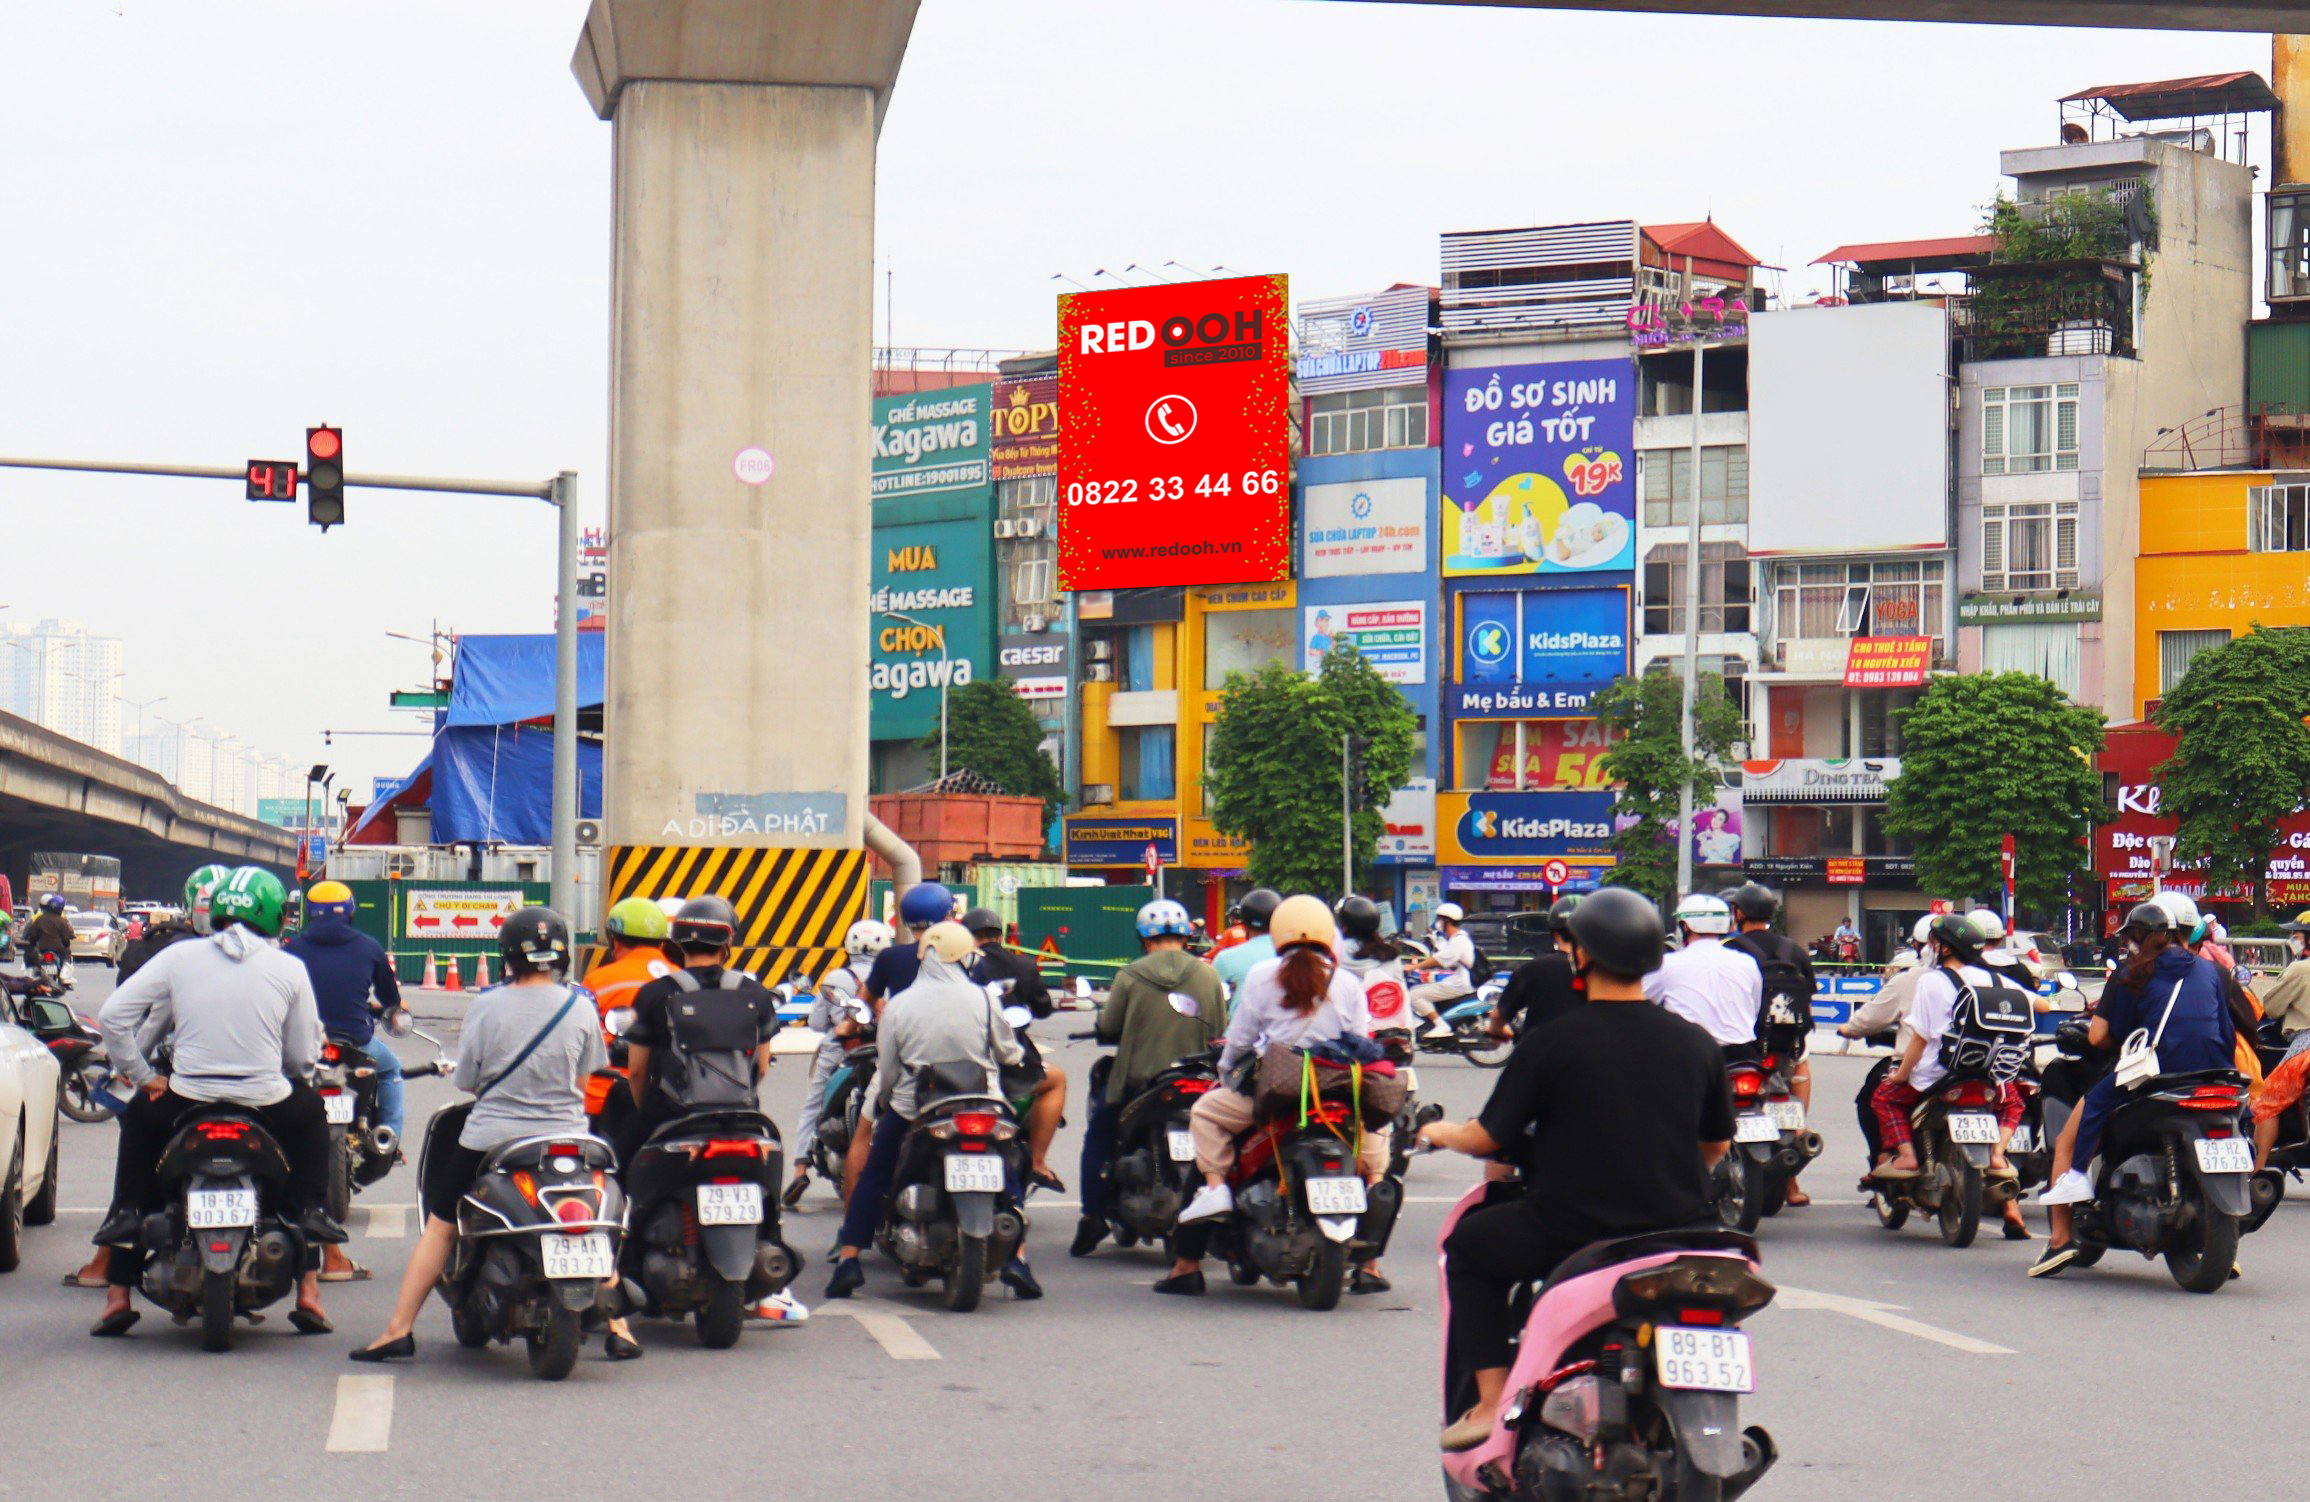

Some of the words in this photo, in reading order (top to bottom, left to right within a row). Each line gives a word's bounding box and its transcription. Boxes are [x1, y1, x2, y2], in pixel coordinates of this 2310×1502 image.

[1081, 320, 1155, 355] RED
[1161, 309, 1262, 347] OOH
[1170, 348, 1213, 365] since
[1218, 345, 1255, 361] 2010
[1464, 372, 1503, 412] ĐỒ
[1510, 379, 1546, 409] SƠ
[1551, 377, 1616, 406] SINH
[888, 399, 916, 424] GHẾ
[916, 398, 978, 421] MASSAGE
[1541, 405, 1596, 443] TỐT
[872, 420, 979, 464] Kagawa
[250, 466, 295, 497] 41
[1067, 478, 1138, 506] 0822
[1149, 476, 1184, 501] 33
[1194, 473, 1231, 498] 44
[1242, 470, 1279, 495] 66
[888, 545, 936, 572] MUA
[1102, 540, 1242, 560] www.redooh.vn
[889, 586, 973, 610] MASSAGE
[1875, 600, 1918, 620] YOGA
[879, 624, 944, 656] CHỌN
[1529, 631, 1622, 650] KidsPlaza
[1853, 642, 1872, 654] CHO
[1874, 640, 1896, 653] THUÊ
[1904, 638, 1927, 652] TẦNG
[1000, 645, 1064, 666] caesar
[1863, 656, 1899, 668] NGUYỄN
[870, 658, 972, 699] agawa
[1462, 692, 1492, 713] Mẹ
[1495, 684, 1533, 709] bầu
[1537, 691, 1550, 708] &
[1555, 691, 1586, 708] Em
[662, 819, 683, 836] A
[764, 807, 829, 838] PHẬT
[1502, 817, 1610, 839] KidsPlaza
[2112, 832, 2144, 851] Độc
[2129, 856, 2150, 869] Đào
[216, 891, 254, 908] Grab
[192, 1209, 250, 1225] 903.67
[703, 1204, 757, 1221] 579.29
[1666, 1359, 1746, 1388] 963.52
